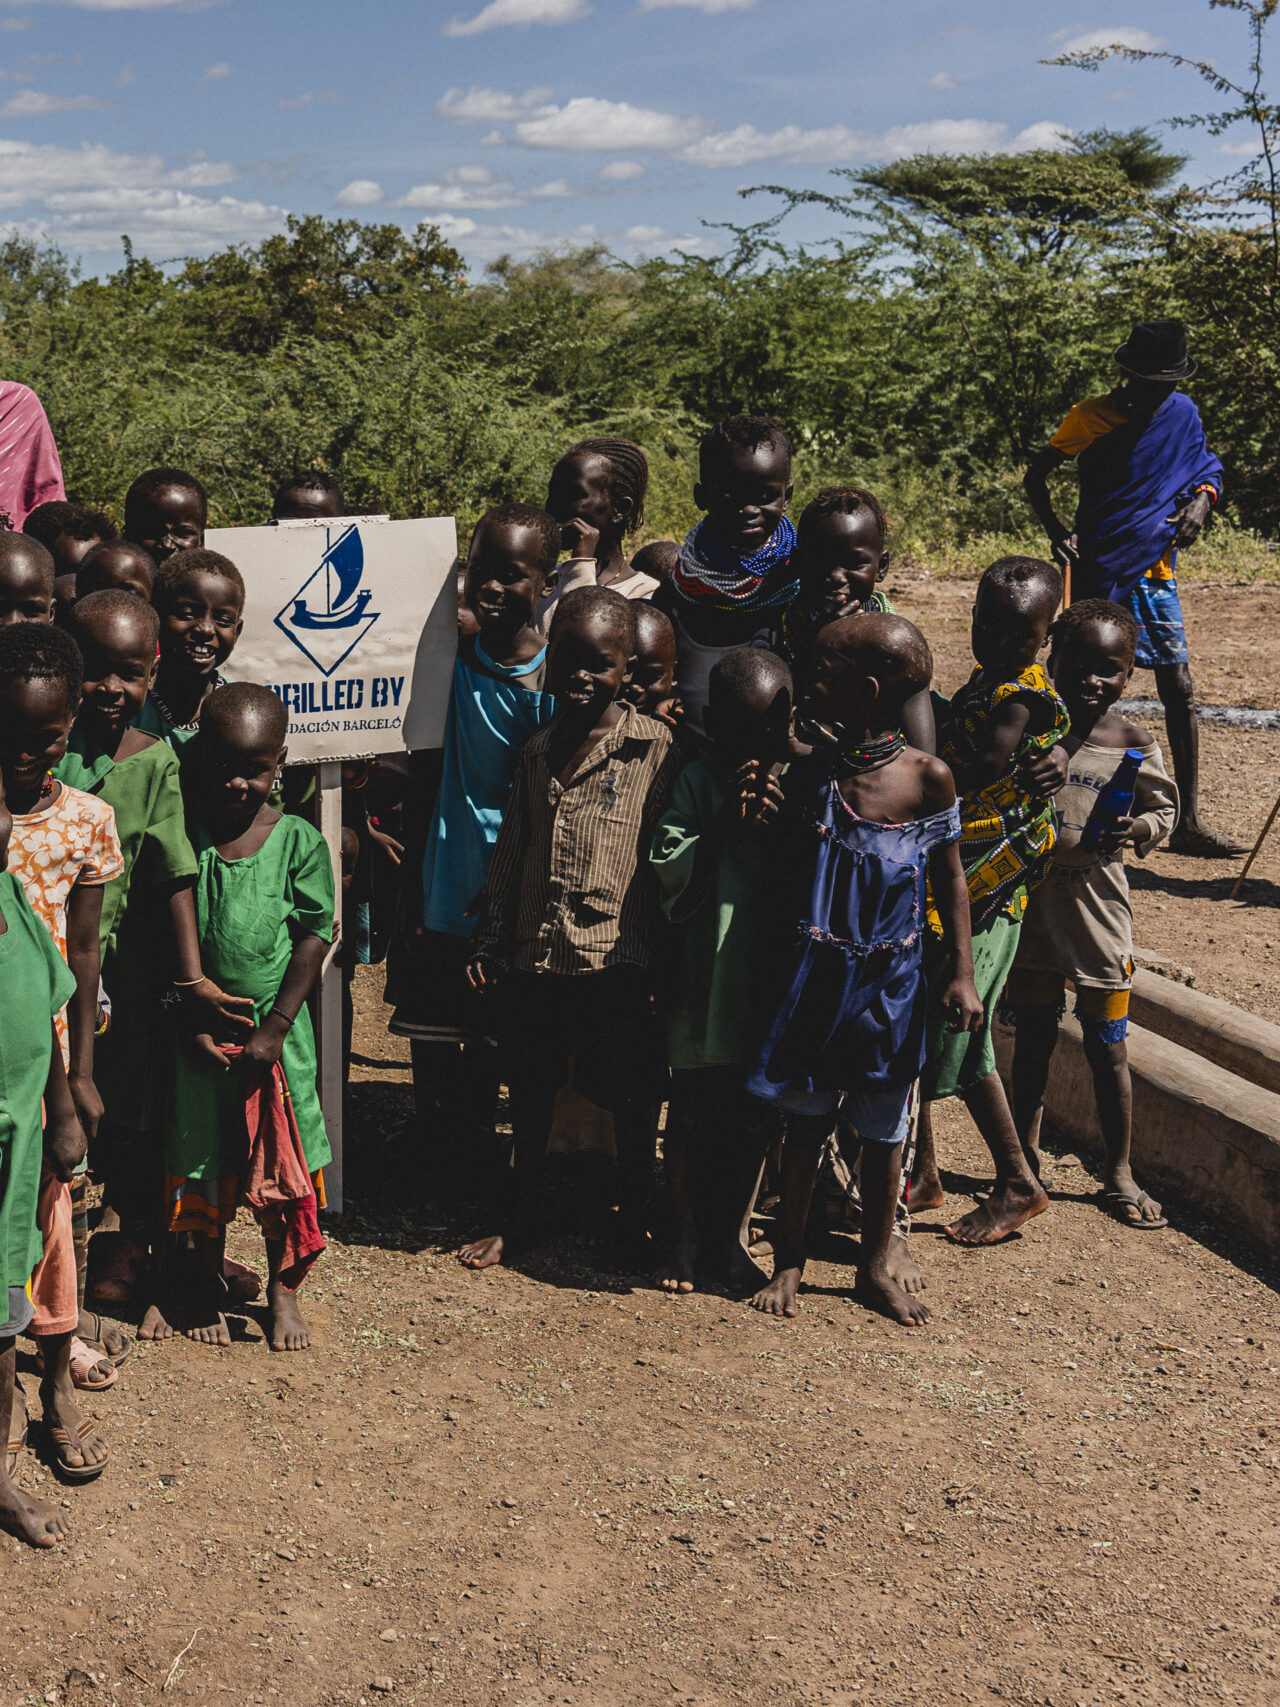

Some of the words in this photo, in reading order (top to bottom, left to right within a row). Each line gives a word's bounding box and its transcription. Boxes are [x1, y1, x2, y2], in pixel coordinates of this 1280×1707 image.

[371, 676, 405, 708] BY
[285, 719, 340, 734] NDACIÓN
[343, 716, 402, 731] BARCELÓ
